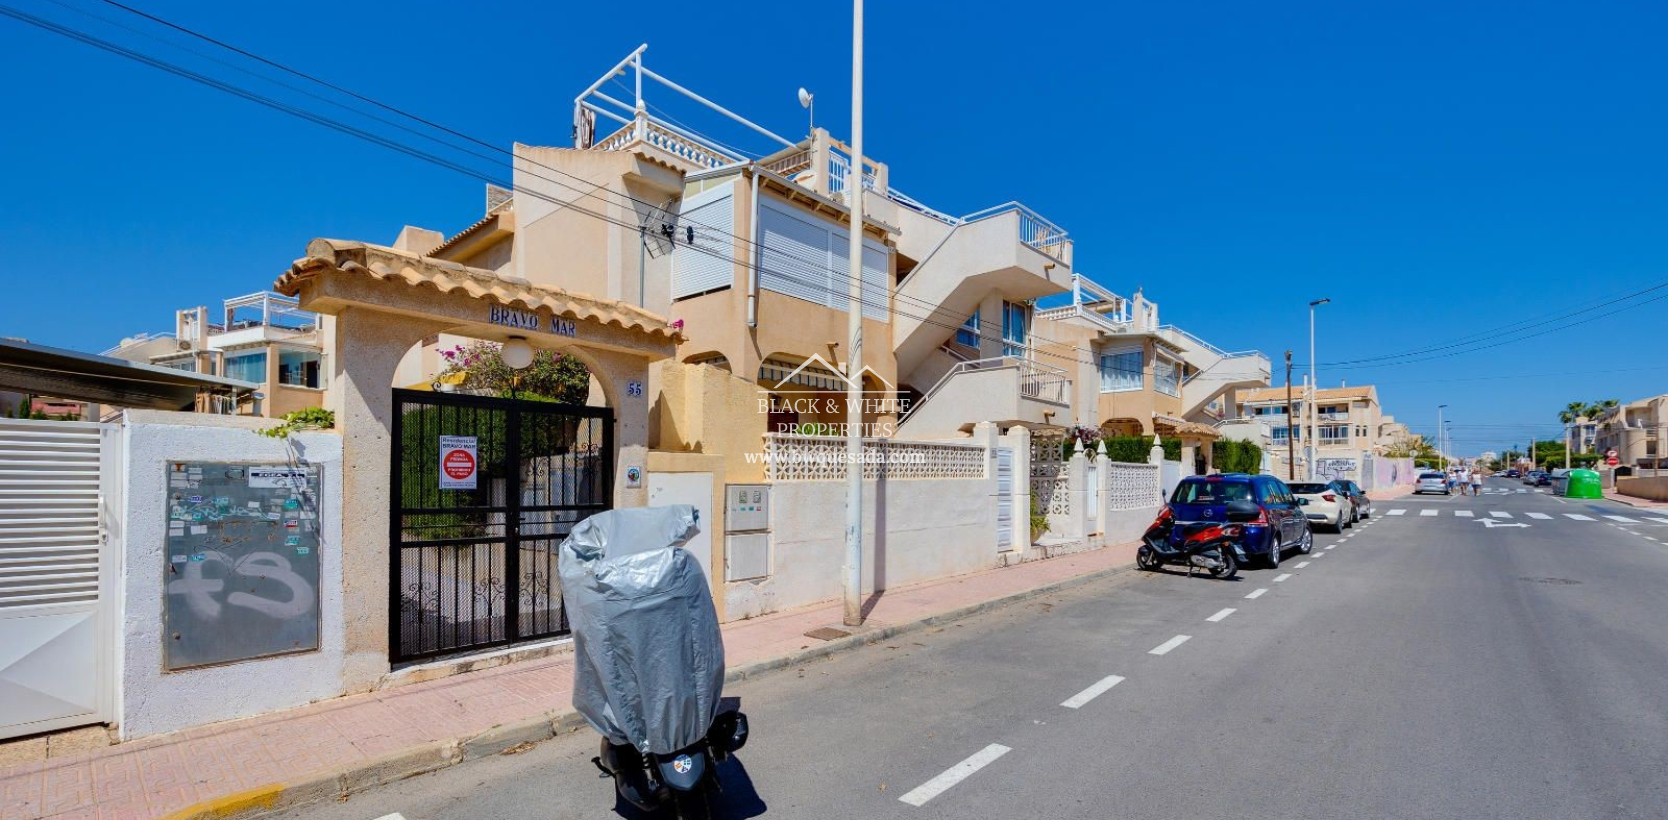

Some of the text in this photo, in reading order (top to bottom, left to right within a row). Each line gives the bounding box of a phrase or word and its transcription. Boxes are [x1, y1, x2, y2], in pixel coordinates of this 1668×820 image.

[490, 306, 576, 336] BRAVO MAR
[628, 382, 642, 396] 55
